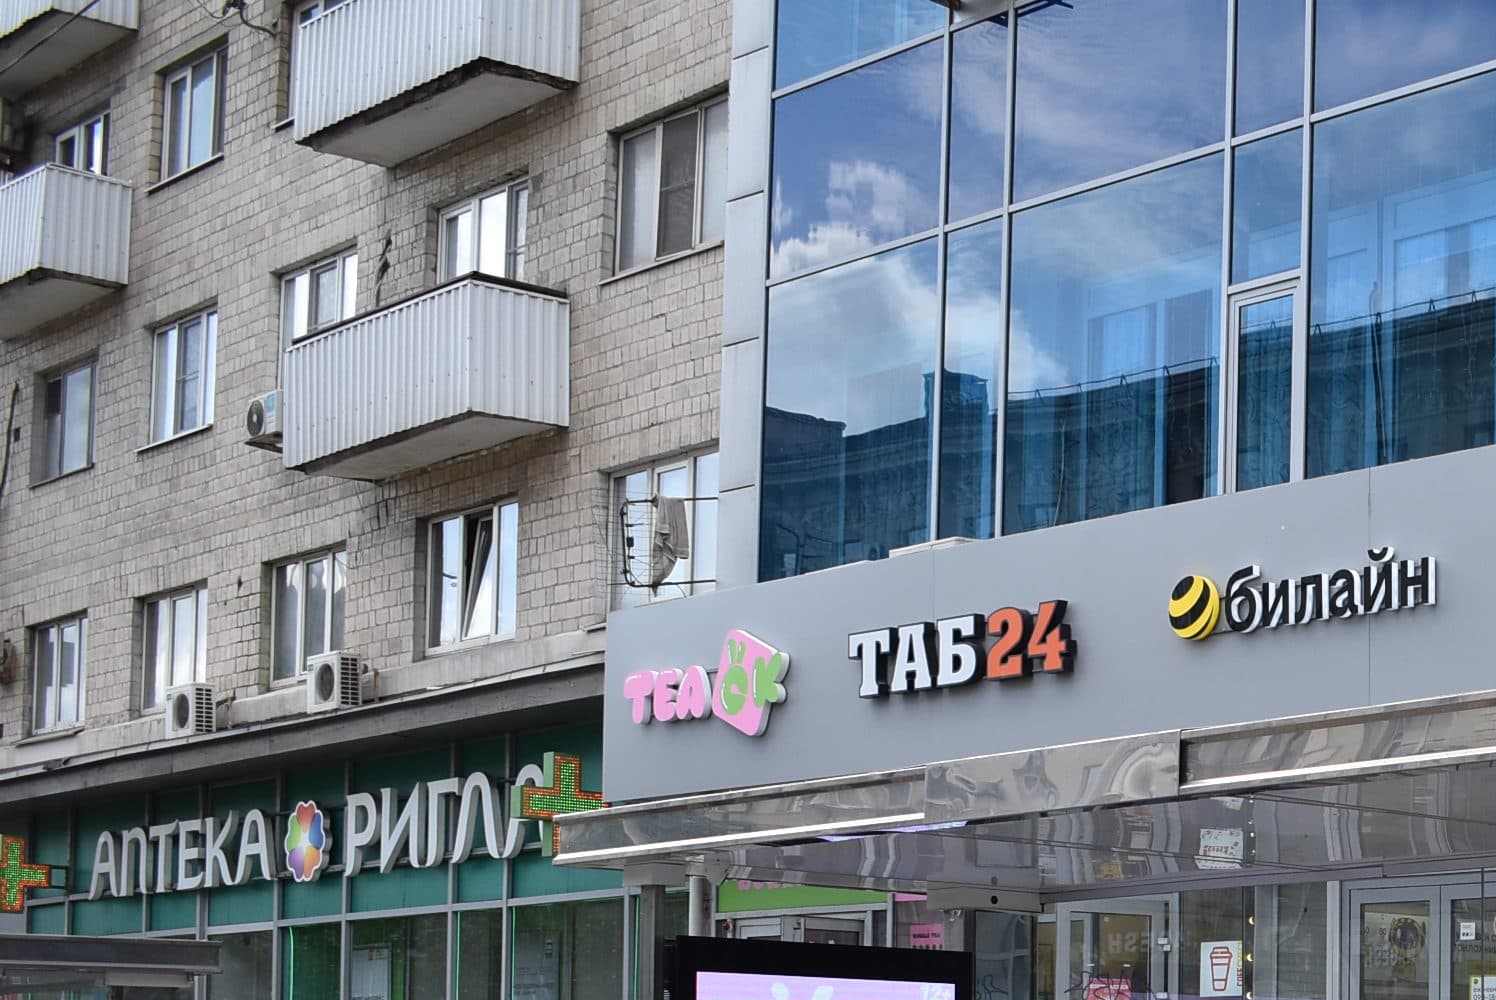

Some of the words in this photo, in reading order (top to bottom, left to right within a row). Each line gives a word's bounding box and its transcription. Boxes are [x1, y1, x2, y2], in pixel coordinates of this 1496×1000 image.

[1224, 545, 1438, 634] билайн
[848, 599, 1075, 699] ТАБ24
[89, 808, 277, 900] АПТЕКА
